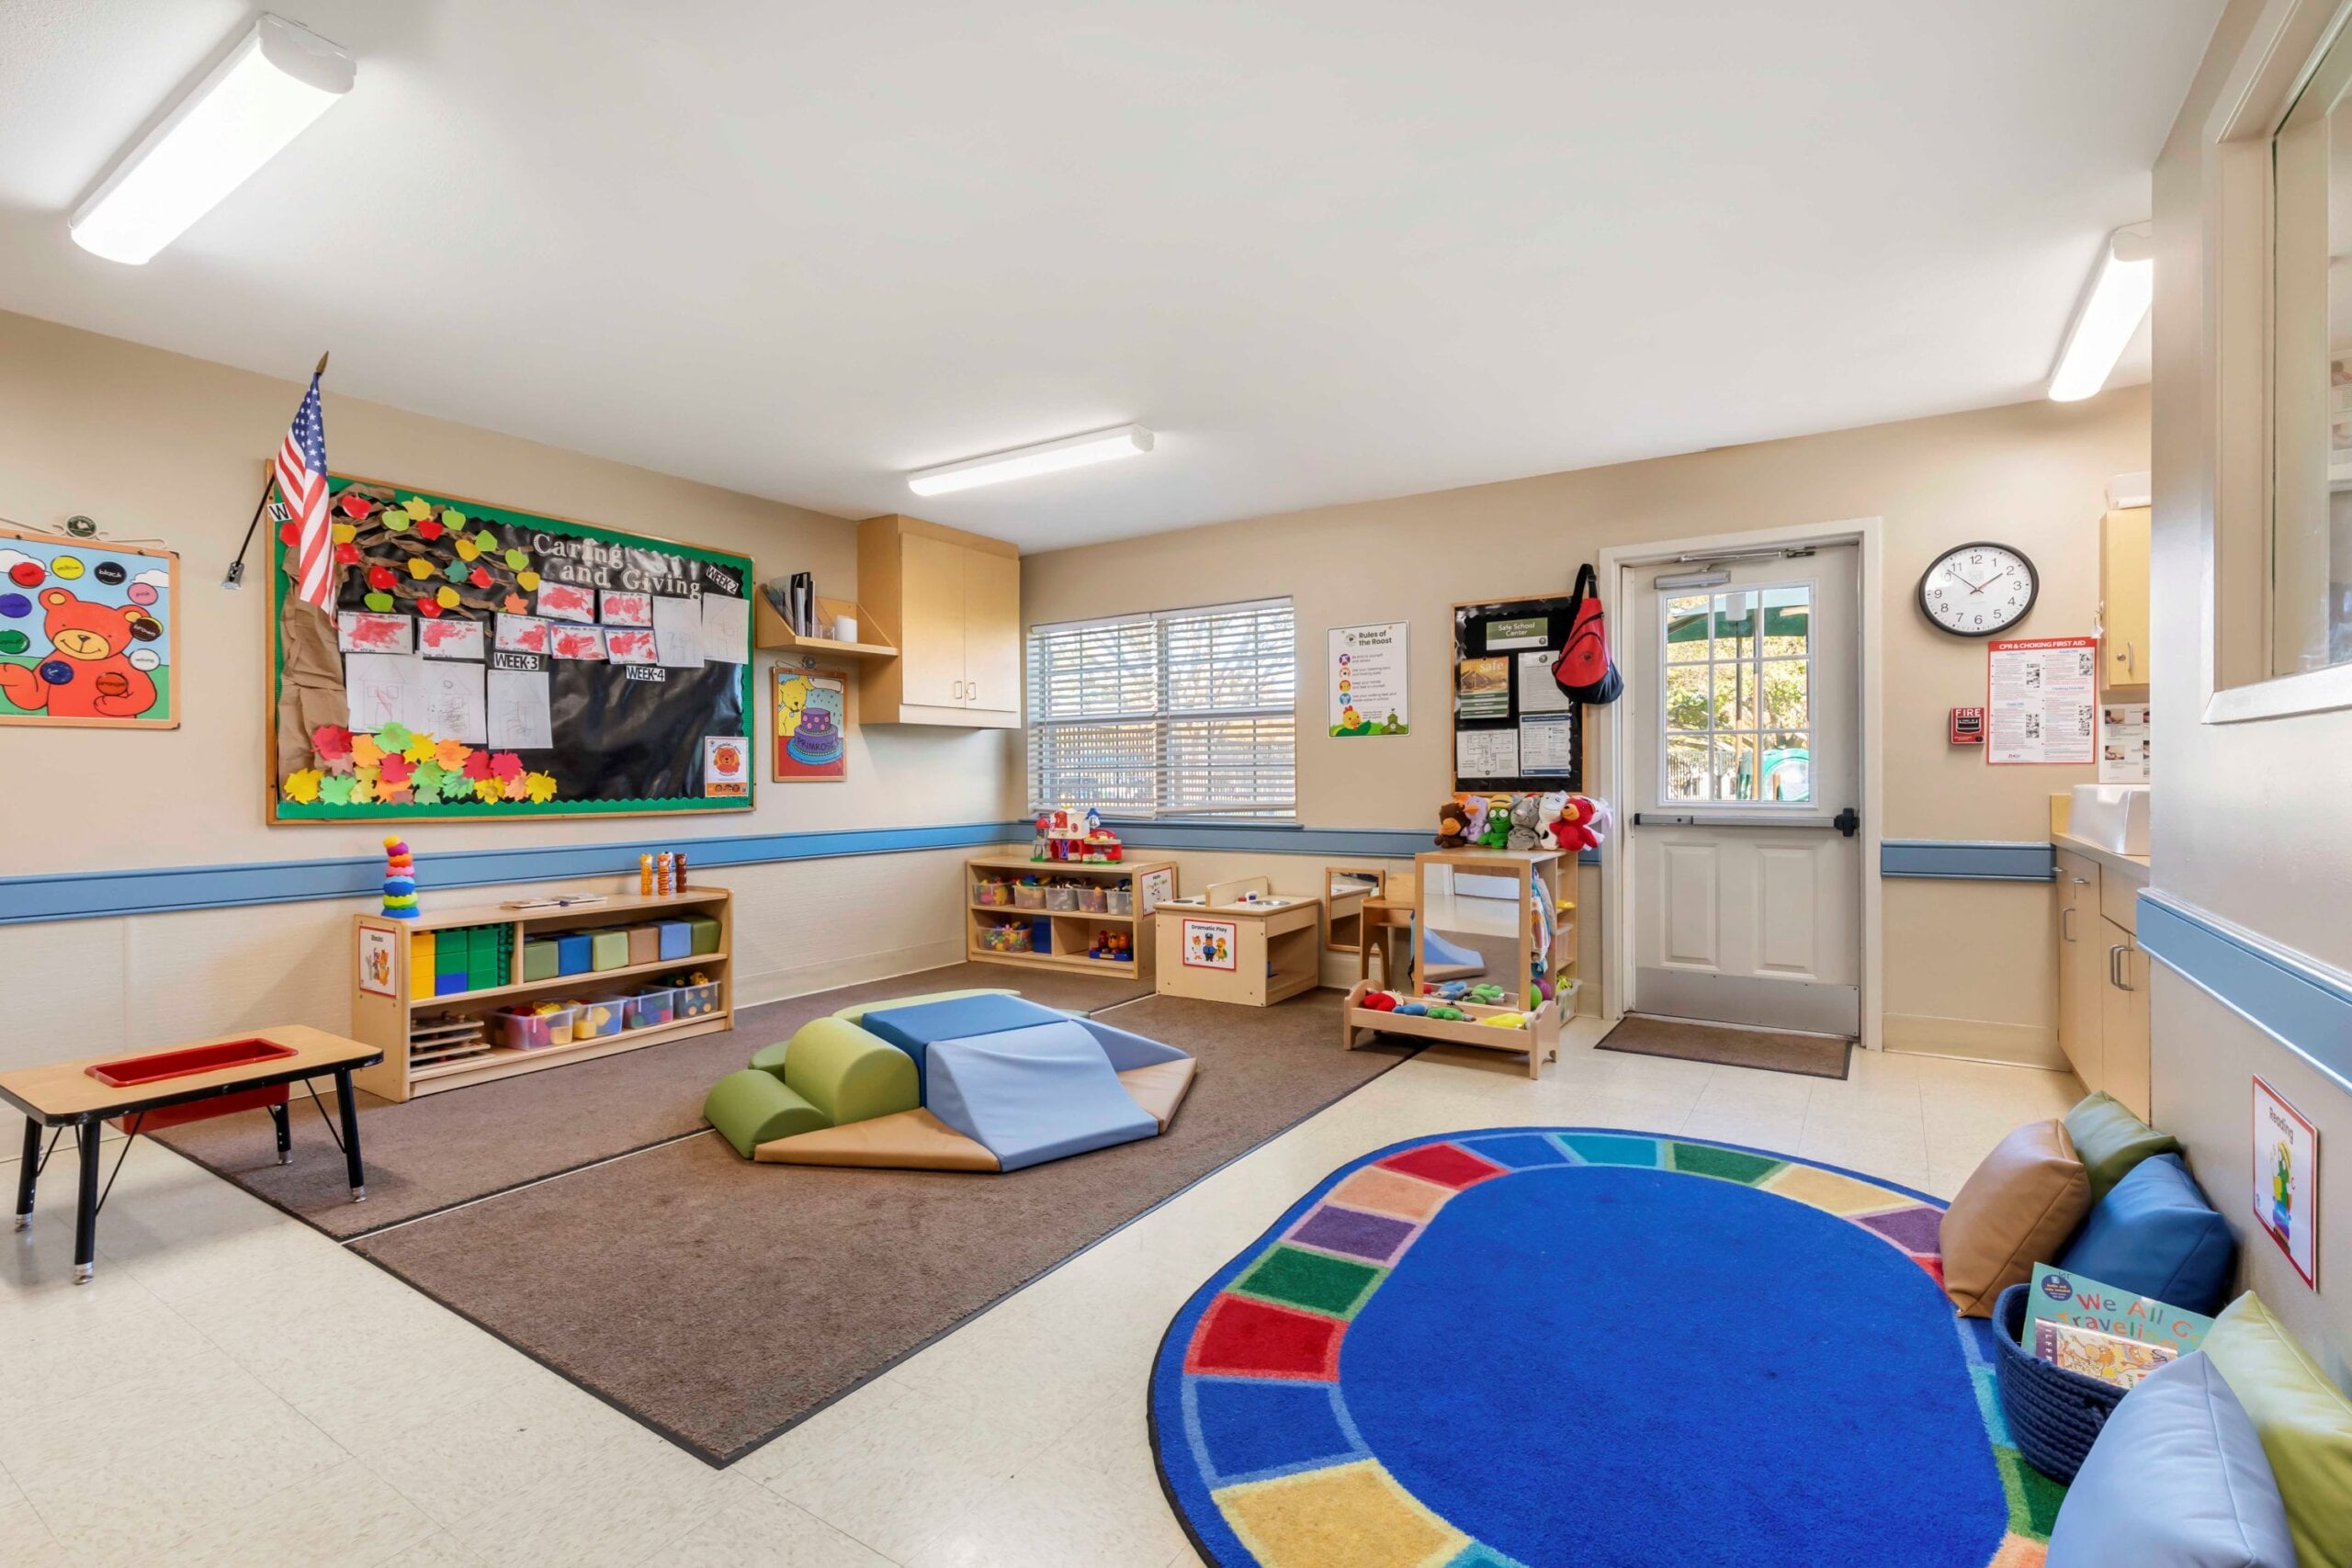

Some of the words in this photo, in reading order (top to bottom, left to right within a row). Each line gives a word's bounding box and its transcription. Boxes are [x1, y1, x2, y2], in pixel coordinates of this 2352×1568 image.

[533, 534, 624, 569] Caring
[1970, 554, 1983, 564] 12
[1992, 558, 1996, 567] 1
[1951, 562, 1962, 571] 11
[2007, 566, 2015, 575] 2
[561, 565, 611, 588] and
[622, 569, 701, 600] Giving
[707, 565, 739, 593] WEEK-2
[2013, 581, 2021, 591] 3
[1934, 590, 1942, 599] 9
[2007, 597, 2016, 605] 4
[1940, 603, 1949, 613] 8
[1956, 613, 1964, 622] 7
[1994, 609, 2002, 618] 5
[1974, 615, 1983, 625] 6
[1513, 622, 1535, 630] School
[1372, 637, 1392, 646] Roost
[495, 653, 538, 670] WEEK-3
[1479, 660, 1504, 672] safe
[627, 666, 664, 681] WEEK-4
[1956, 708, 1982, 716] FIRE
[2269, 1106, 2294, 1145] Reading
[2076, 1293, 2117, 1312] We
[2128, 1300, 2164, 1325] All
